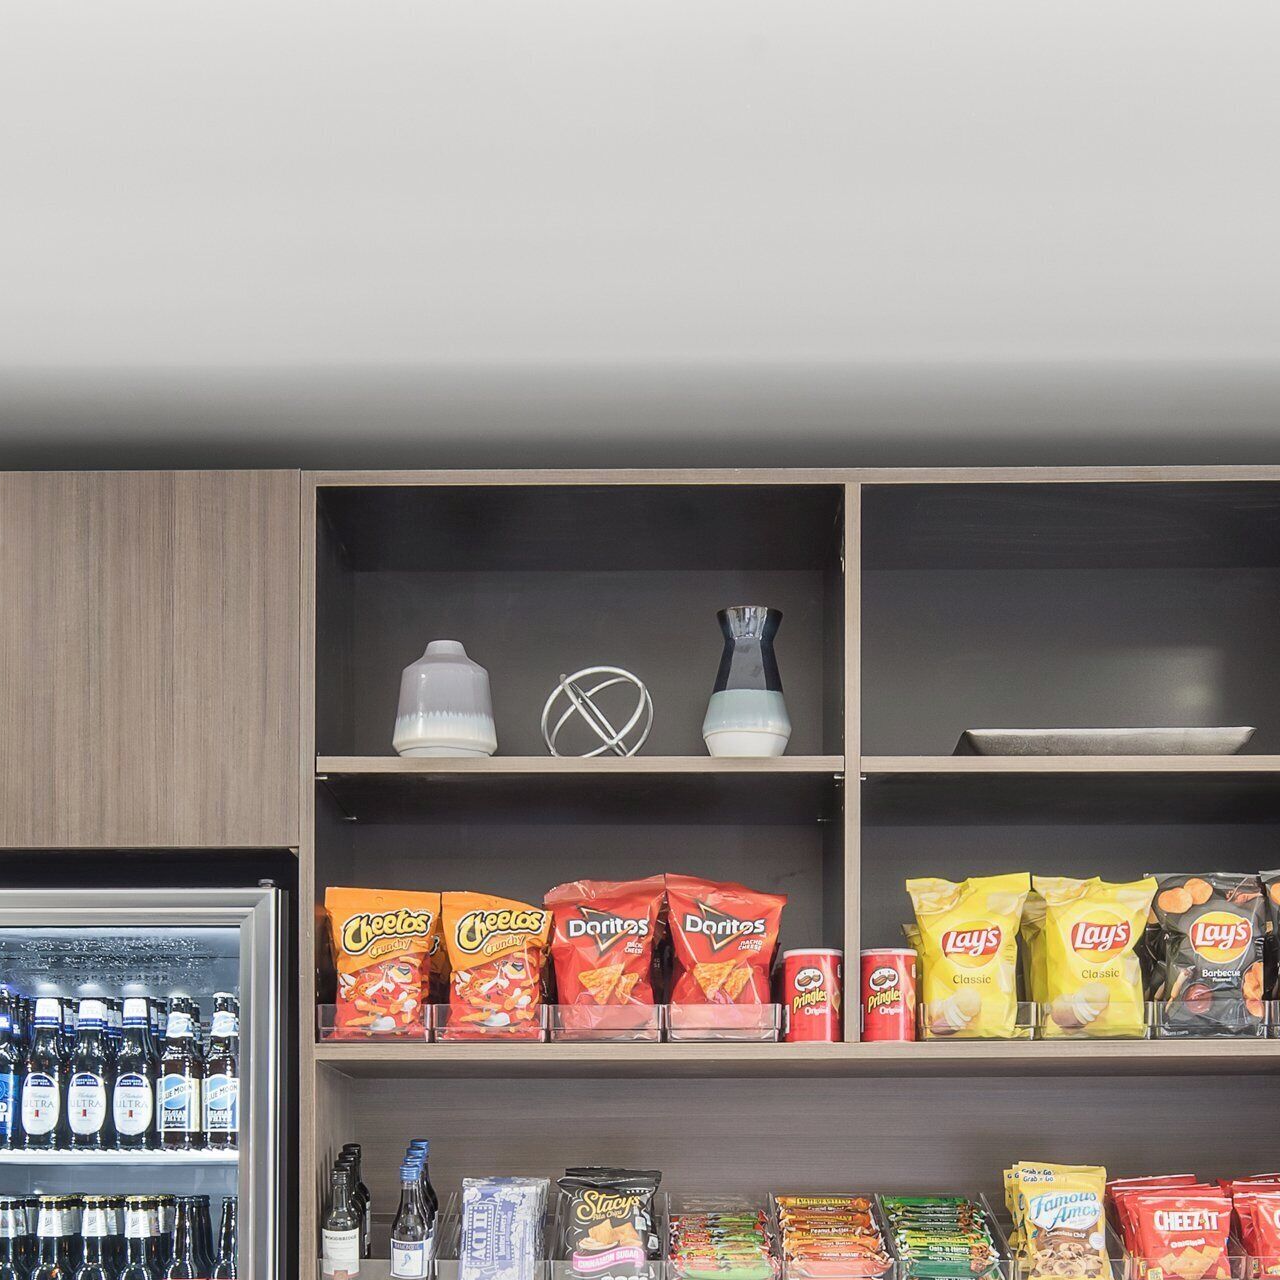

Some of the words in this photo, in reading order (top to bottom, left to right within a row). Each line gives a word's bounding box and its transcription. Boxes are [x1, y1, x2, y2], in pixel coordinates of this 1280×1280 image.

[342, 908, 433, 954] Cheetos
[456, 909, 546, 953] Cheetos
[569, 918, 649, 937] Doritos
[685, 915, 766, 936] Doritos
[1075, 920, 1130, 952] Lay's
[1195, 921, 1249, 950] Lay's
[369, 938, 412, 958] Crunchy
[484, 934, 526, 956] Crunchy
[945, 928, 1000, 957] Lay's
[953, 973, 992, 985] Classic
[1081, 968, 1120, 979] Classic
[1202, 969, 1241, 978] Barbecue
[793, 987, 828, 1014] Pringles
[804, 1006, 829, 1016] Original
[868, 987, 903, 1014] Pringles
[879, 1006, 903, 1015] Original
[70, 1100, 103, 1108] ULTRA
[115, 1100, 148, 1108] ULTRA
[576, 1189, 641, 1221] Stacy's
[1029, 1192, 1097, 1220] Famous
[1045, 1205, 1101, 1229] Amos
[1153, 1209, 1220, 1231] CHEEZ-IT
[1073, 1231, 1086, 1239] Chip
[577, 1252, 616, 1269] CINNAMON
[616, 1249, 640, 1261] SUGAR
